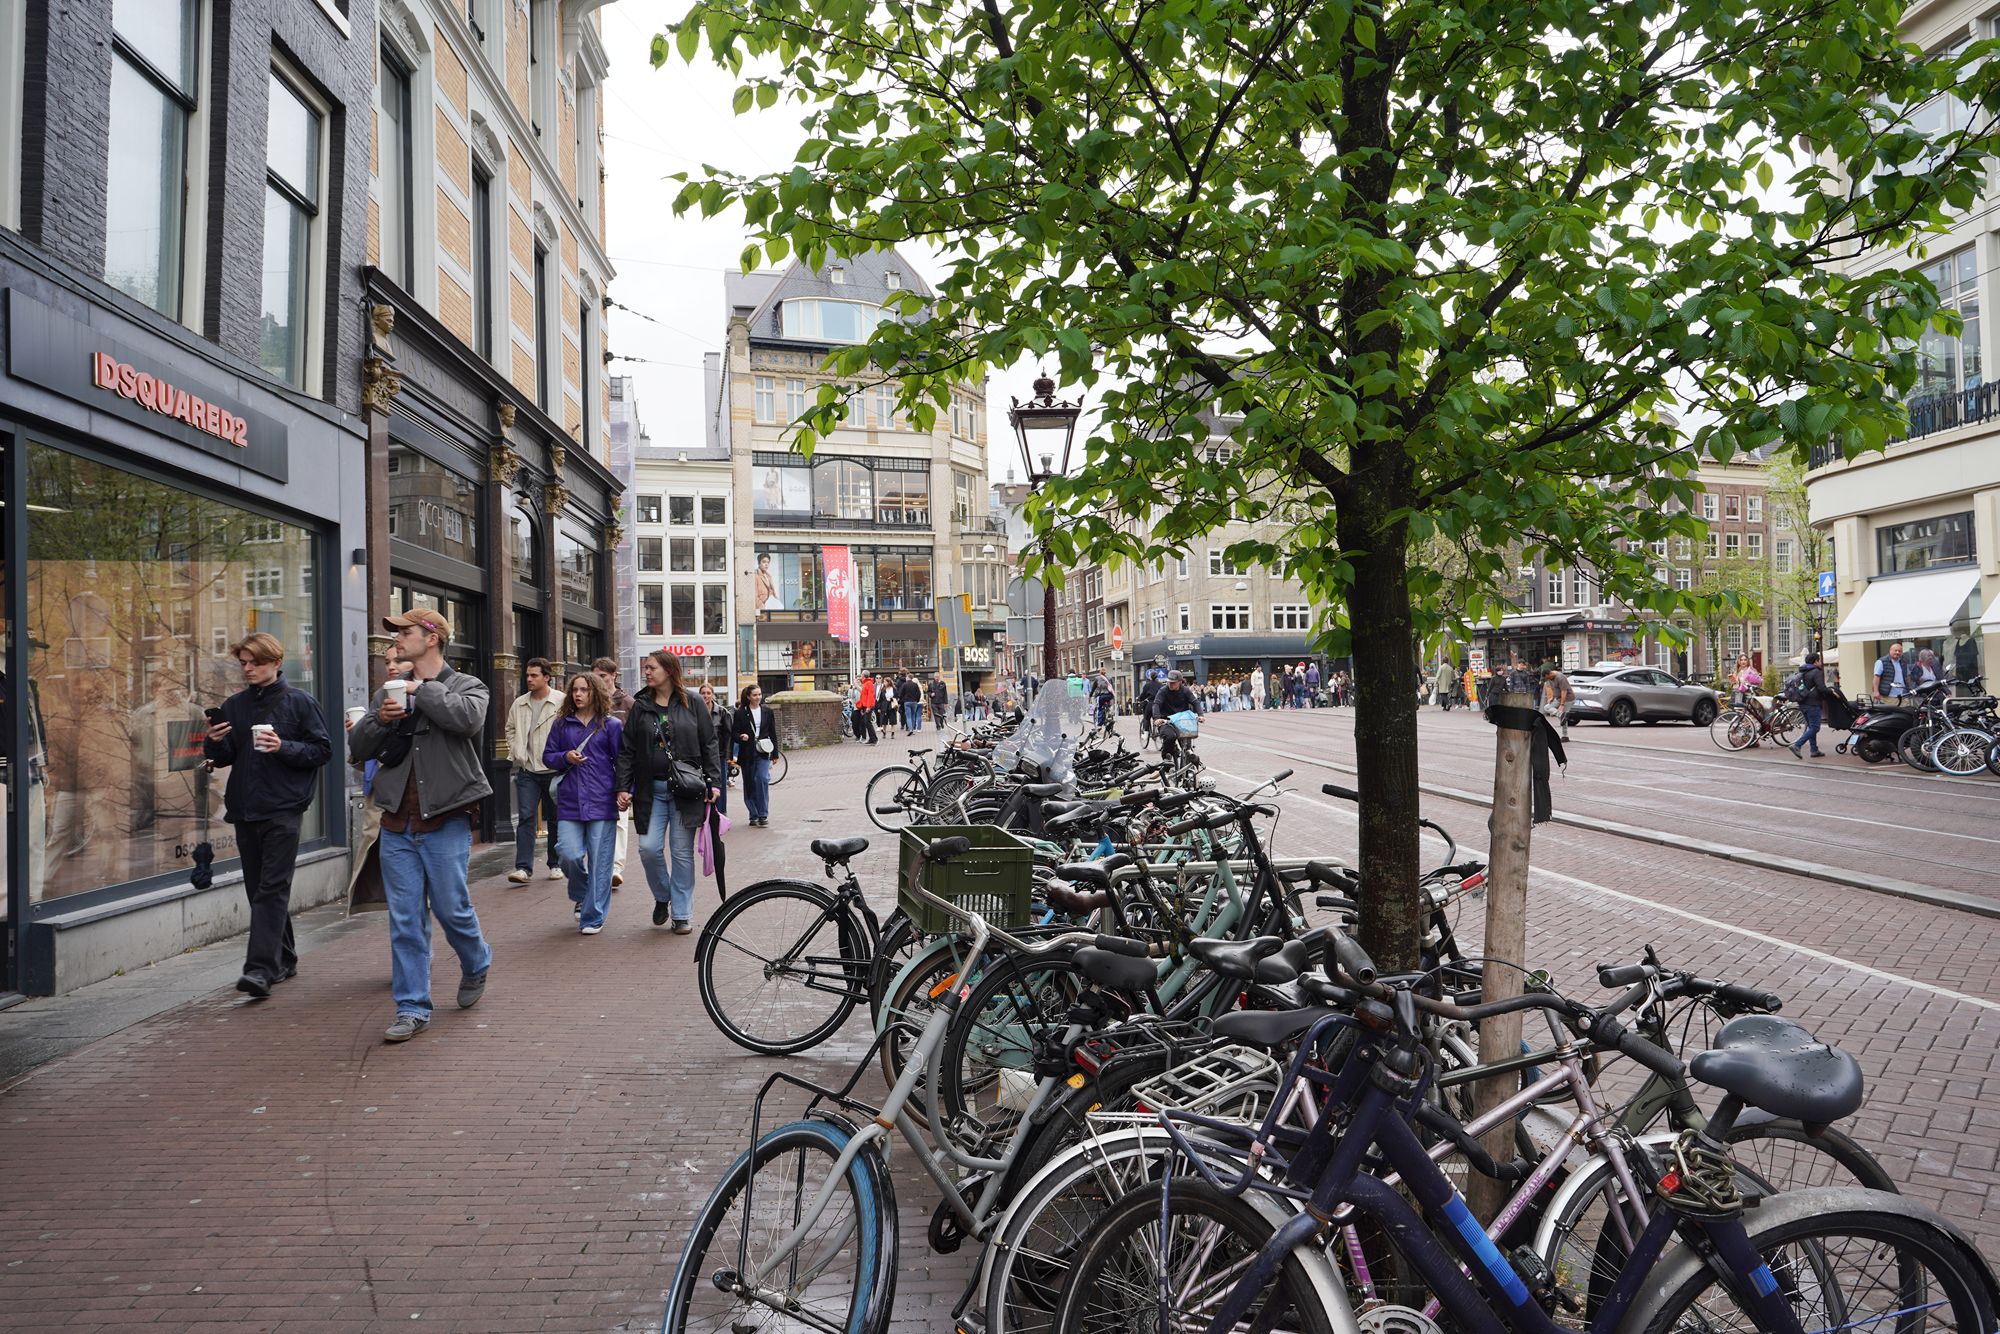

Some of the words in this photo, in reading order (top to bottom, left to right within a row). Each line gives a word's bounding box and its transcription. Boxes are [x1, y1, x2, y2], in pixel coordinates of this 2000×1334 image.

[91, 351, 248, 447] DSQUARED2
[1880, 630, 1902, 639] ARKET
[663, 644, 705, 656] HUGO
[1167, 643, 1200, 651] CHEESE
[964, 647, 990, 663] BOSS
